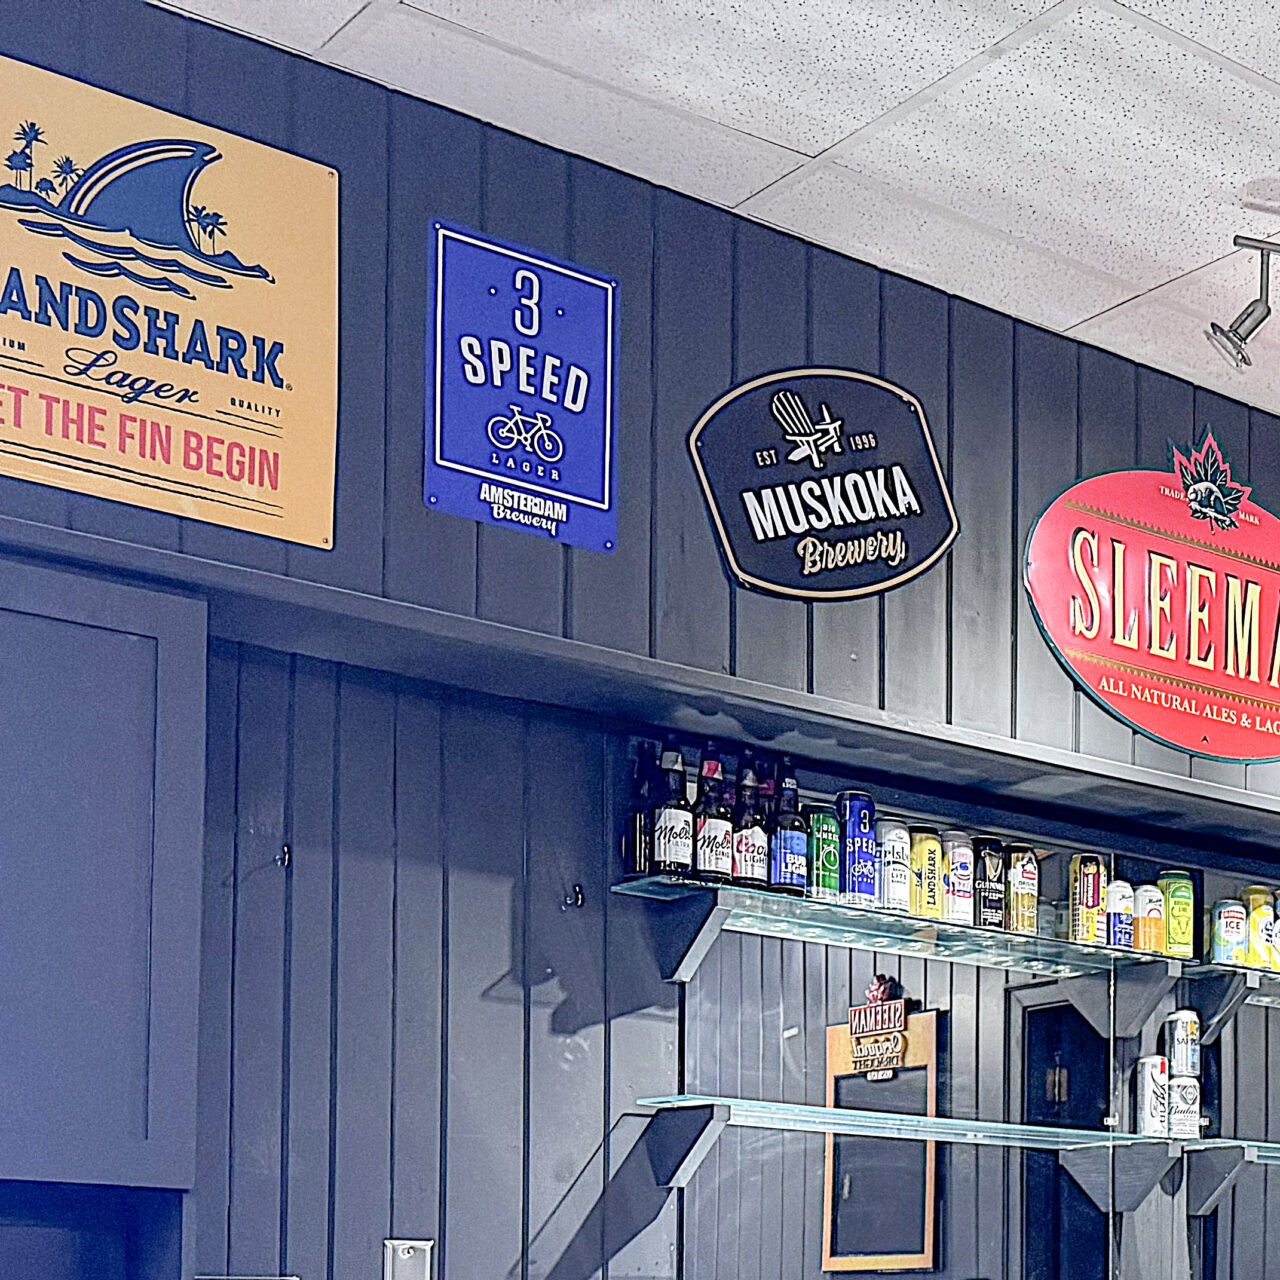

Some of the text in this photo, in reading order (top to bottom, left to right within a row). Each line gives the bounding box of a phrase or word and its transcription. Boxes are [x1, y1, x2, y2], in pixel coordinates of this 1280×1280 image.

[514, 269, 541, 337] 3
[63, 347, 200, 404] Lager
[459, 335, 589, 413] SPEED
[230, 397, 282, 418] QUALITY
[39, 393, 107, 450] THE
[118, 413, 172, 465] FIN
[183, 430, 280, 491] BEGIN
[755, 450, 778, 466] EST
[850, 433, 877, 450] 1996
[491, 453, 559, 480] LAGER
[480, 482, 567, 522] AMSTERDAM
[491, 502, 557, 536] Brewery
[742, 465, 921, 541] MUSKOKA
[1159, 485, 1260, 526] TRADE MARK
[796, 530, 906, 575] Brewery
[1098, 676, 1128, 697] ALL
[1130, 684, 1200, 717] NATURAL
[1202, 703, 1237, 726] ALES
[1240, 711, 1252, 728] &
[860, 809, 870, 833] 3
[744, 853, 767, 865] LIGH
[926, 848, 937, 906] LANDSHARK
[1225, 920, 1241, 930] ICE
